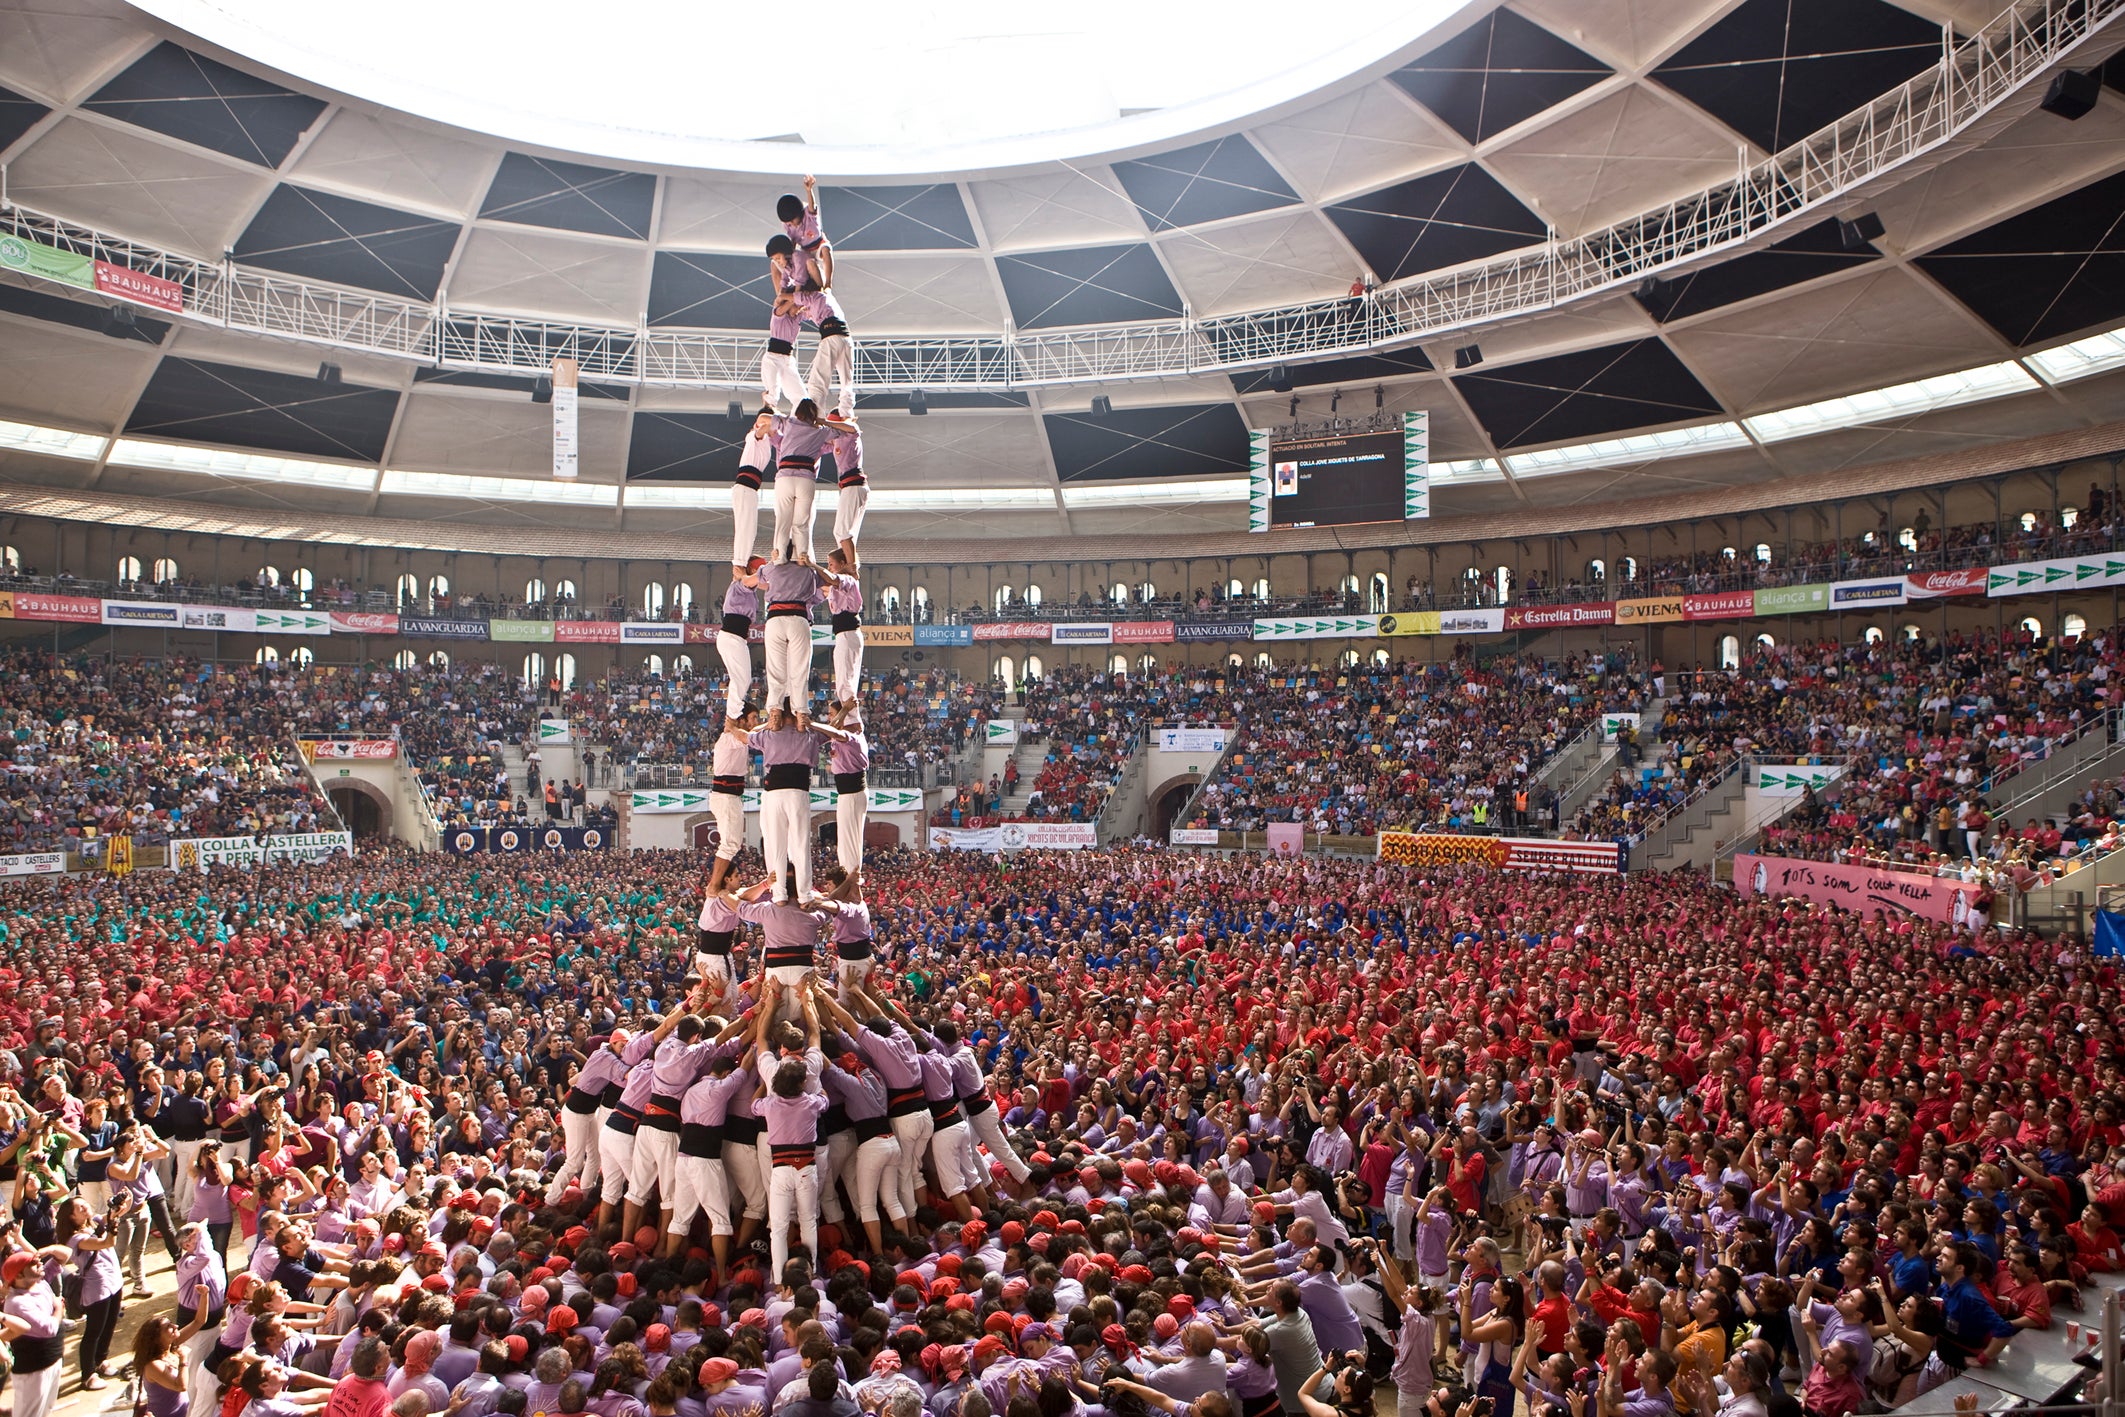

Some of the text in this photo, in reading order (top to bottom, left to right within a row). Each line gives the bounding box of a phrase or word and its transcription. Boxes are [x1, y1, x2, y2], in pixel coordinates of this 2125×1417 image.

[111, 274, 180, 302] BAUHAUS
[1356, 454, 1385, 462] TARRAGONA
[1926, 571, 1969, 588] Coca-Cola
[1761, 590, 1806, 605] aliança
[31, 601, 98, 614] BAUHAUS
[1636, 603, 1682, 617] VIENA
[1695, 598, 1752, 611] BAUHAUS
[1524, 608, 1612, 623] Estrella Damm
[404, 622, 485, 634] LA VANGUARDIA
[496, 624, 536, 635] aliança
[919, 630, 955, 639] aliança
[1123, 627, 1173, 636] BAUHAUS
[1178, 627, 1190, 636] LA
[1190, 625, 1250, 636] VANGUARDIA
[872, 631, 912, 641] VIENA
[202, 834, 347, 852] COLLA CASTELLERA
[1027, 834, 1095, 843] XICOTS DE VILAFRANCA
[25, 855, 60, 865] CASTELLERS
[226, 851, 258, 865] PERE
[293, 848, 318, 860] PAU
[1516, 850, 1559, 865] SEMPRE
[1782, 867, 1815, 886] TOTS
[1900, 882, 1932, 900] VELLA
